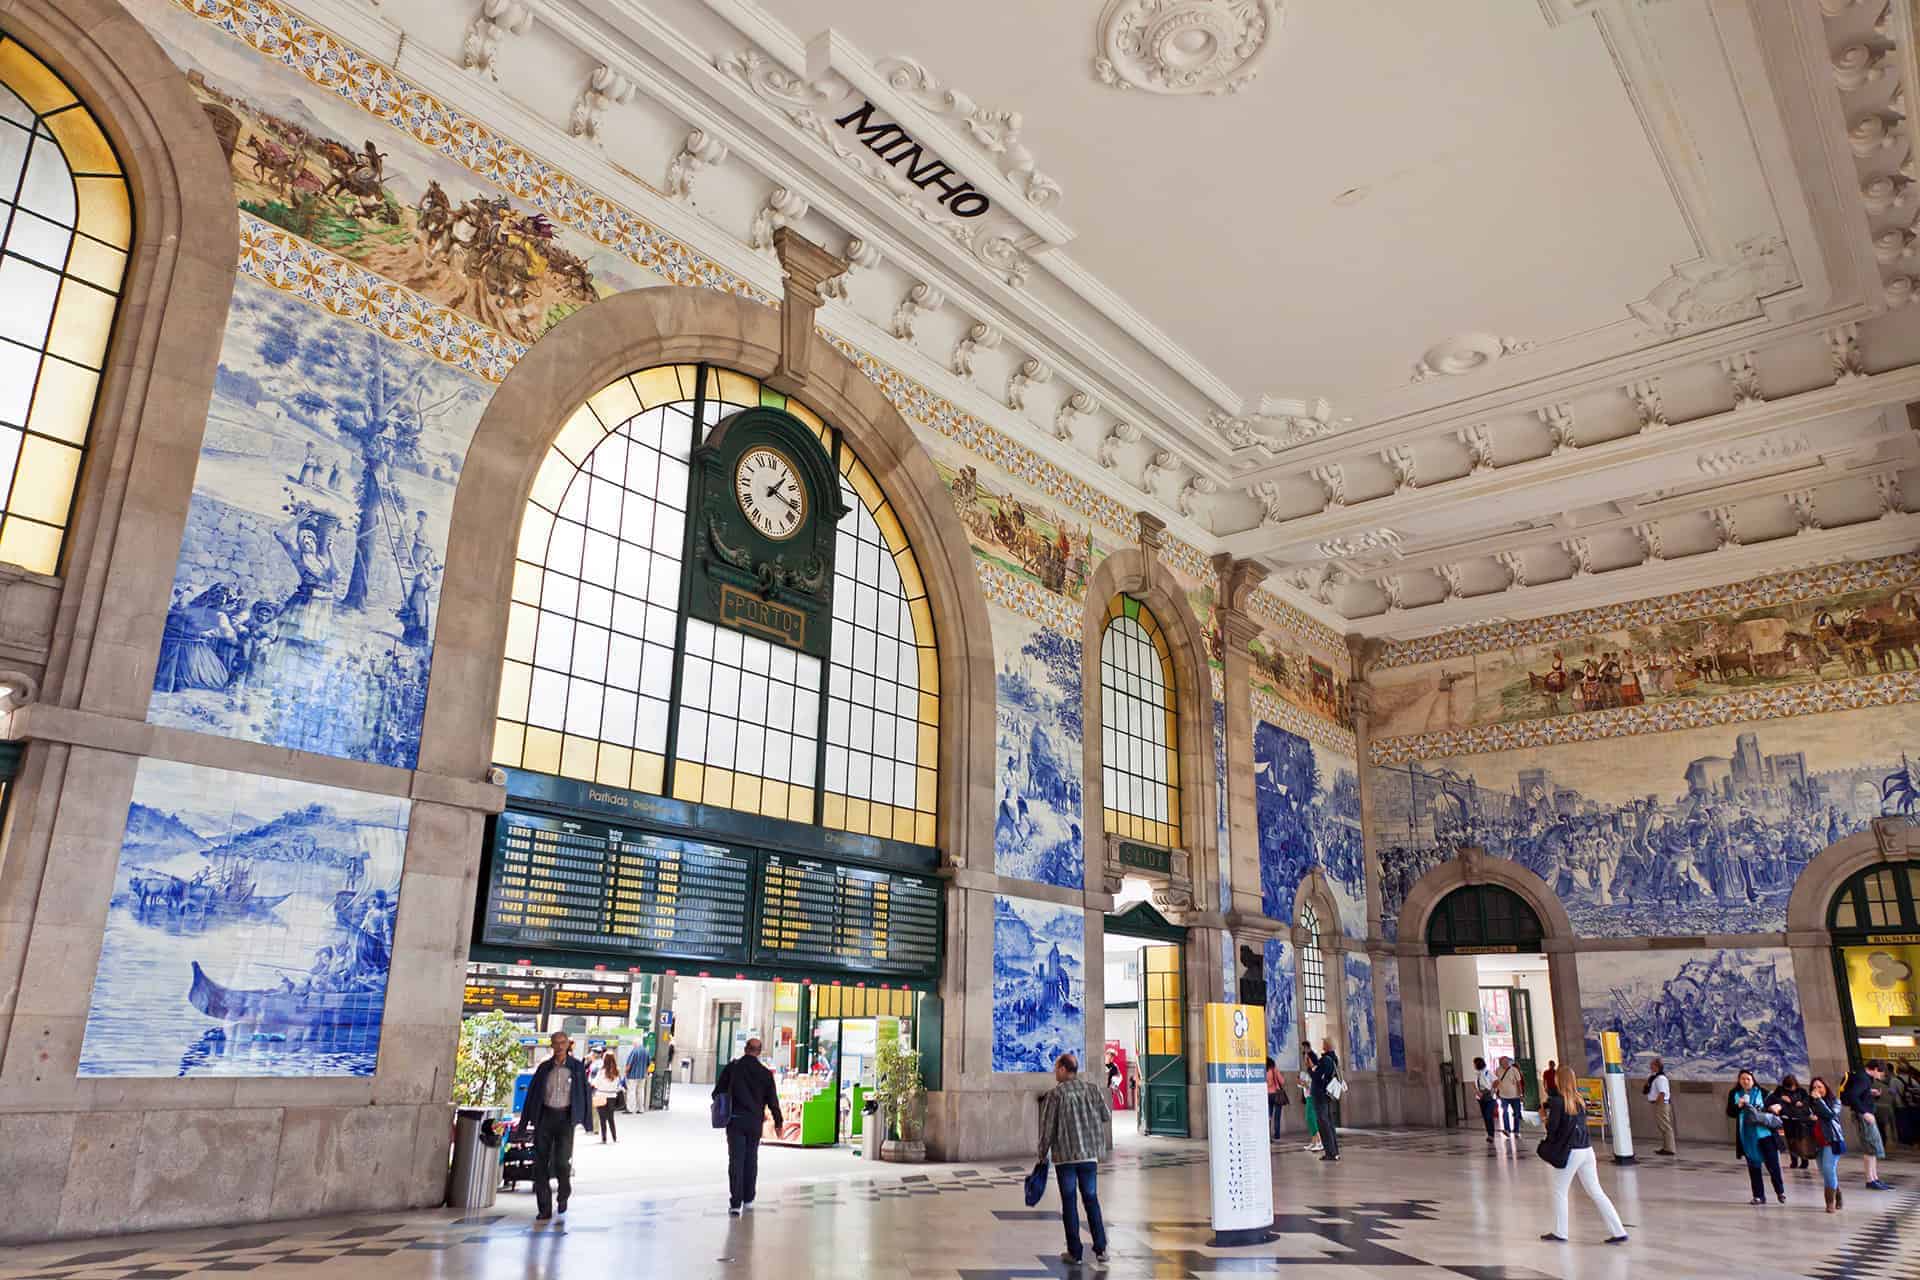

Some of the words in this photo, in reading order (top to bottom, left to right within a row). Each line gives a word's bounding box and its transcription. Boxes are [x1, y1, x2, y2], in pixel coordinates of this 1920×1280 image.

[834, 99, 990, 218] MINHO
[736, 595, 792, 632] PORTO
[588, 788, 629, 807] Partidas
